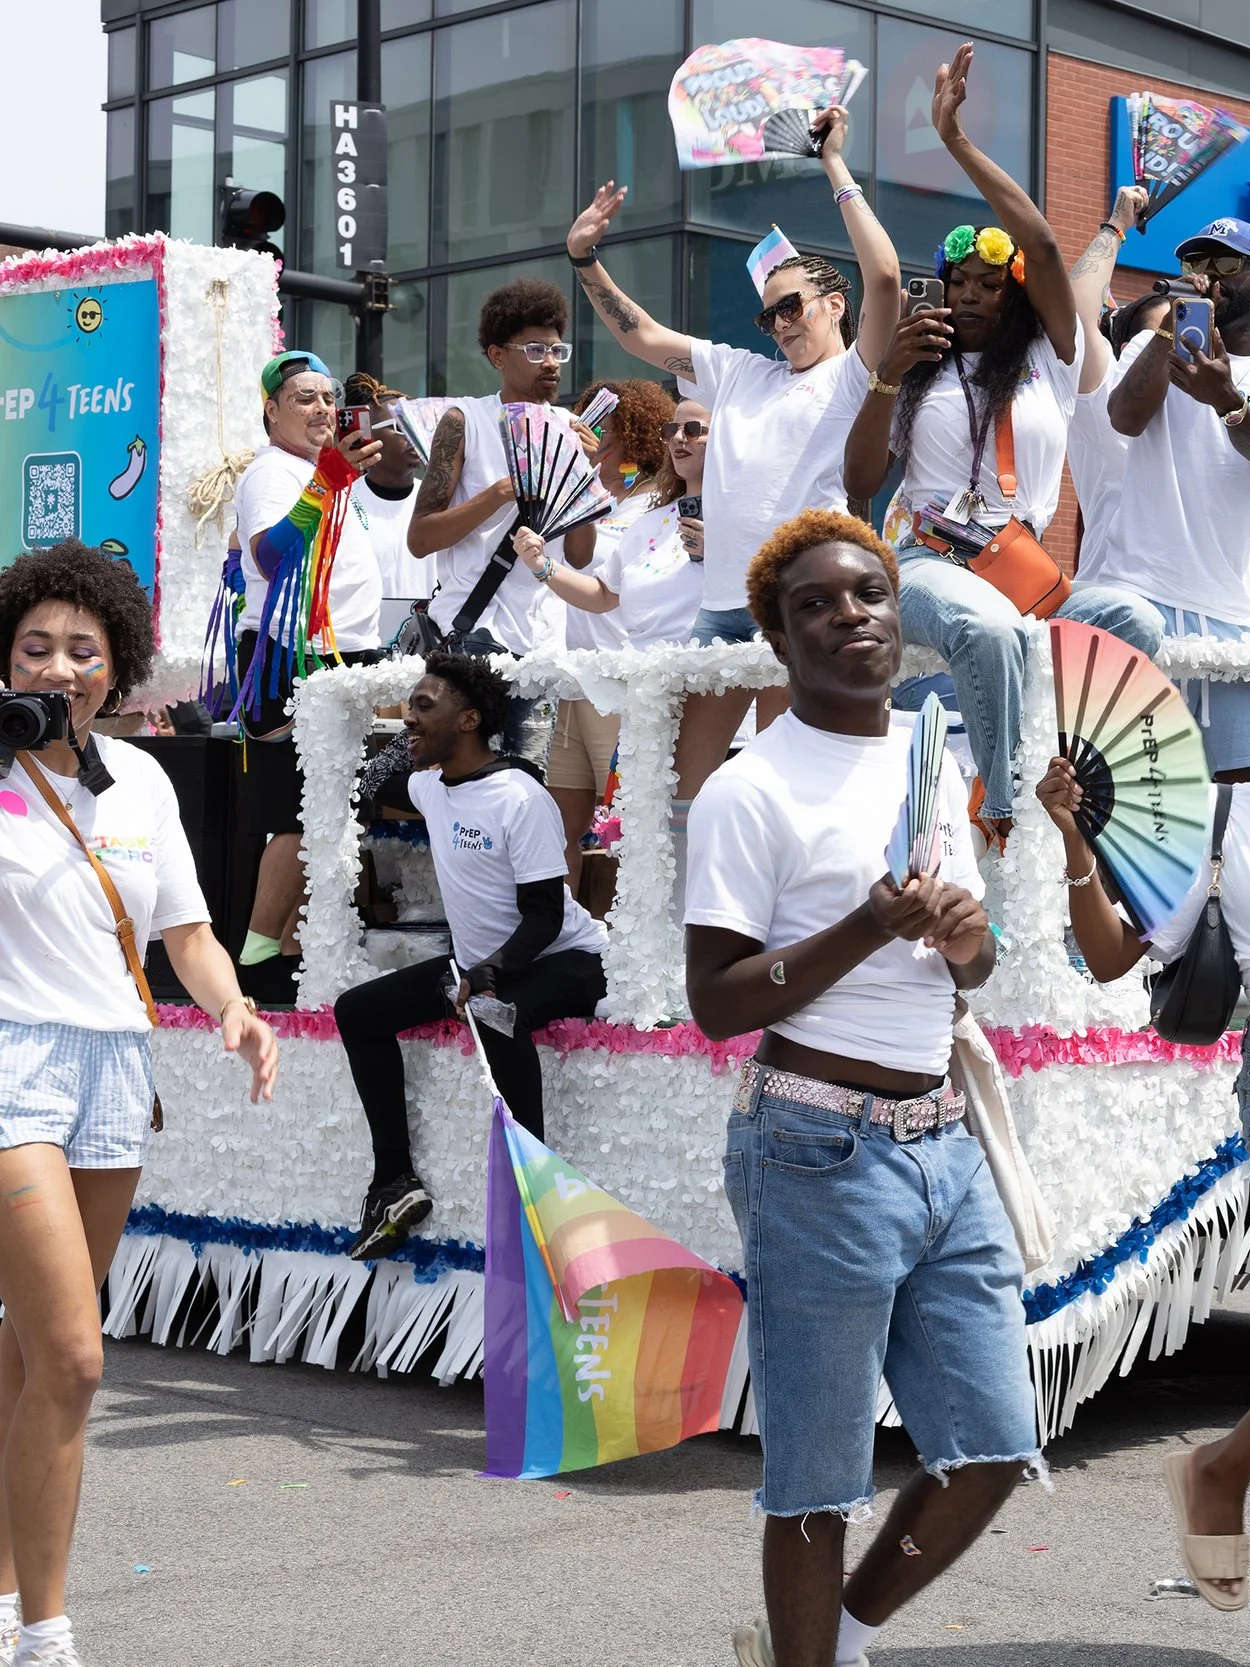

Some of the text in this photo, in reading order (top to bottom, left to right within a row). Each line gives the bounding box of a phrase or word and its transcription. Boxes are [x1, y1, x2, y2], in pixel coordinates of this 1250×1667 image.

[334, 104, 358, 267] HA3601
[37, 371, 66, 432] 4
[67, 377, 135, 420] TEENS
[1140, 714, 1159, 764] PrEP
[1140, 767, 1167, 790] 4
[94, 836, 151, 849] TASK
[452, 833, 482, 851] 4 TEENS
[459, 827, 481, 839] PrEP
[573, 1293, 618, 1402] TEENS
